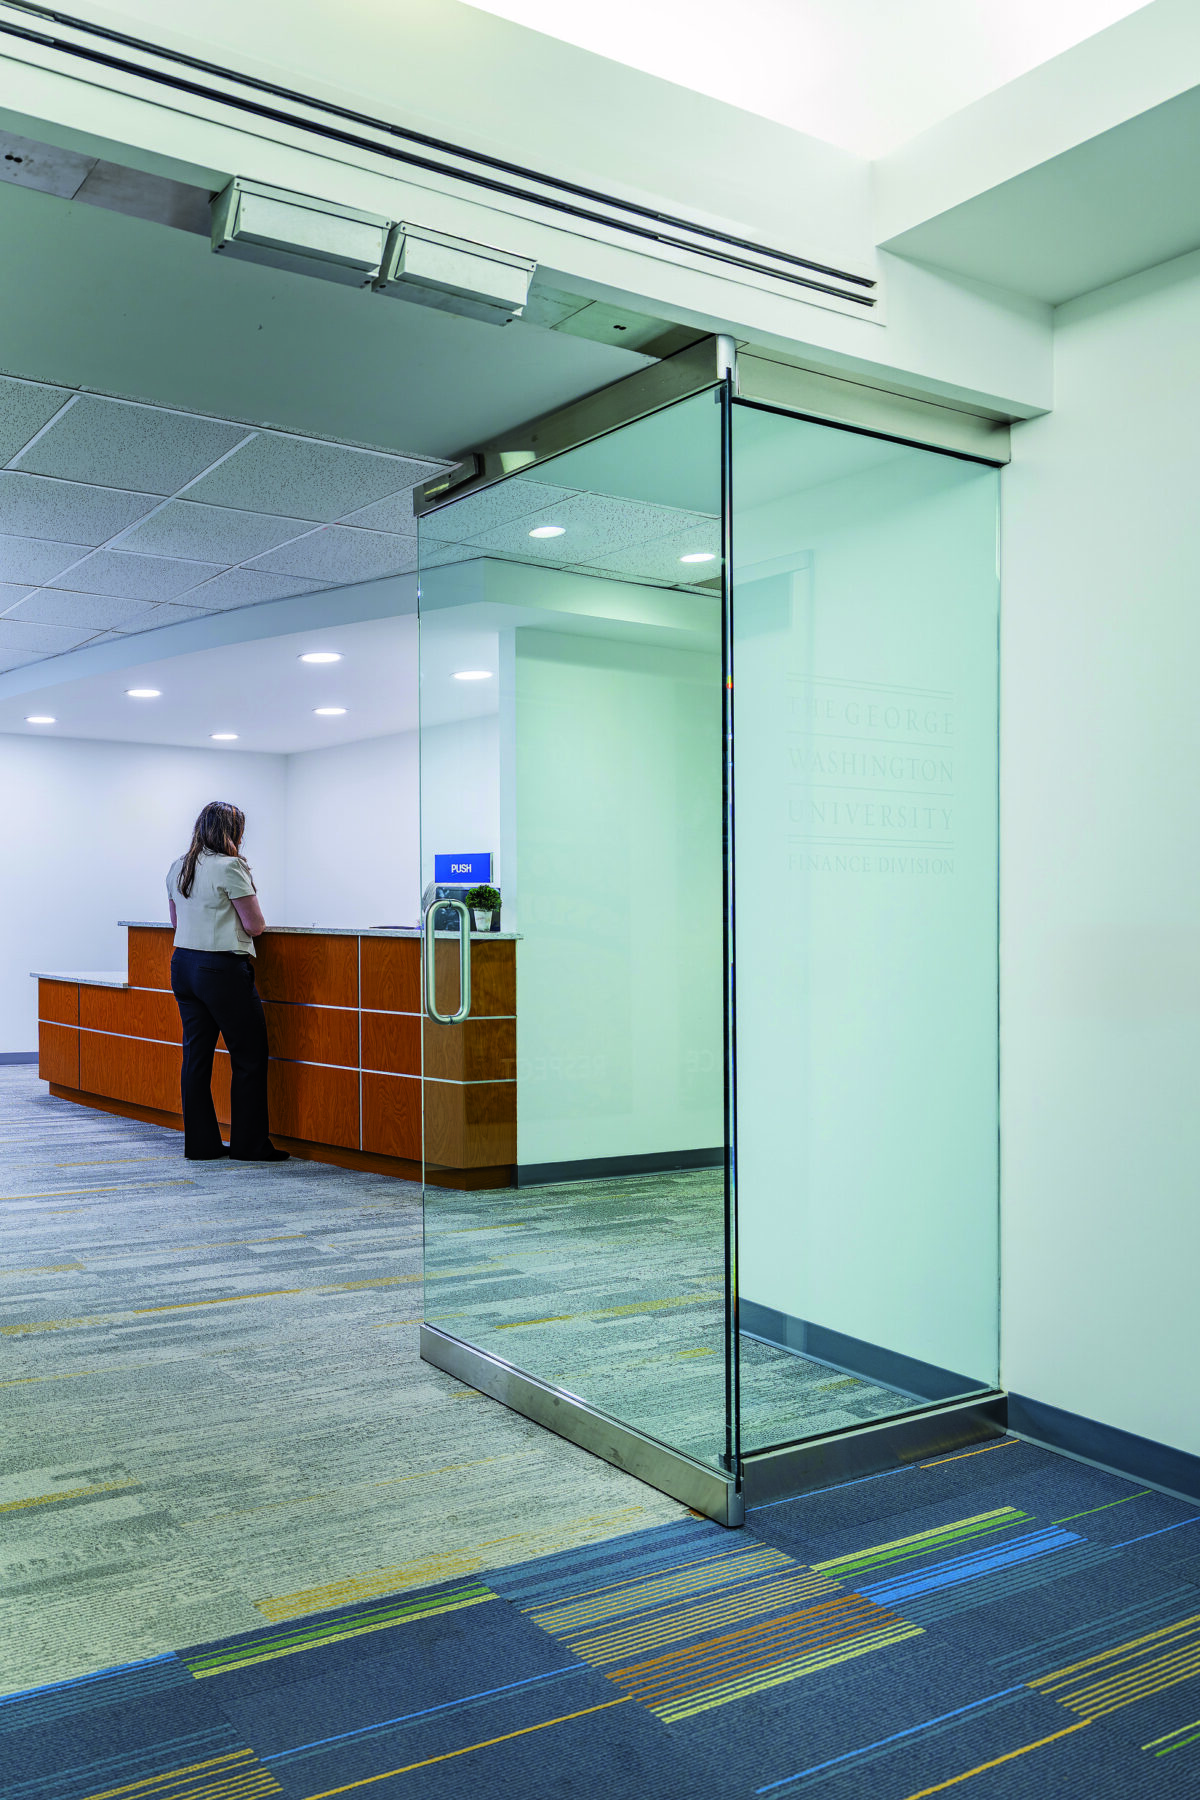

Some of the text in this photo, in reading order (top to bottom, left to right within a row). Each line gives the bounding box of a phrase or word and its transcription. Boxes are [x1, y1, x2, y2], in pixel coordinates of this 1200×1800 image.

[786, 695, 956, 736] THE GEORGE
[787, 746, 954, 784] WASHINGTON
[787, 799, 954, 831] UNIVERSITY
[451, 863, 472, 873] PUSH
[787, 852, 956, 876] FINANCE DIVISION
